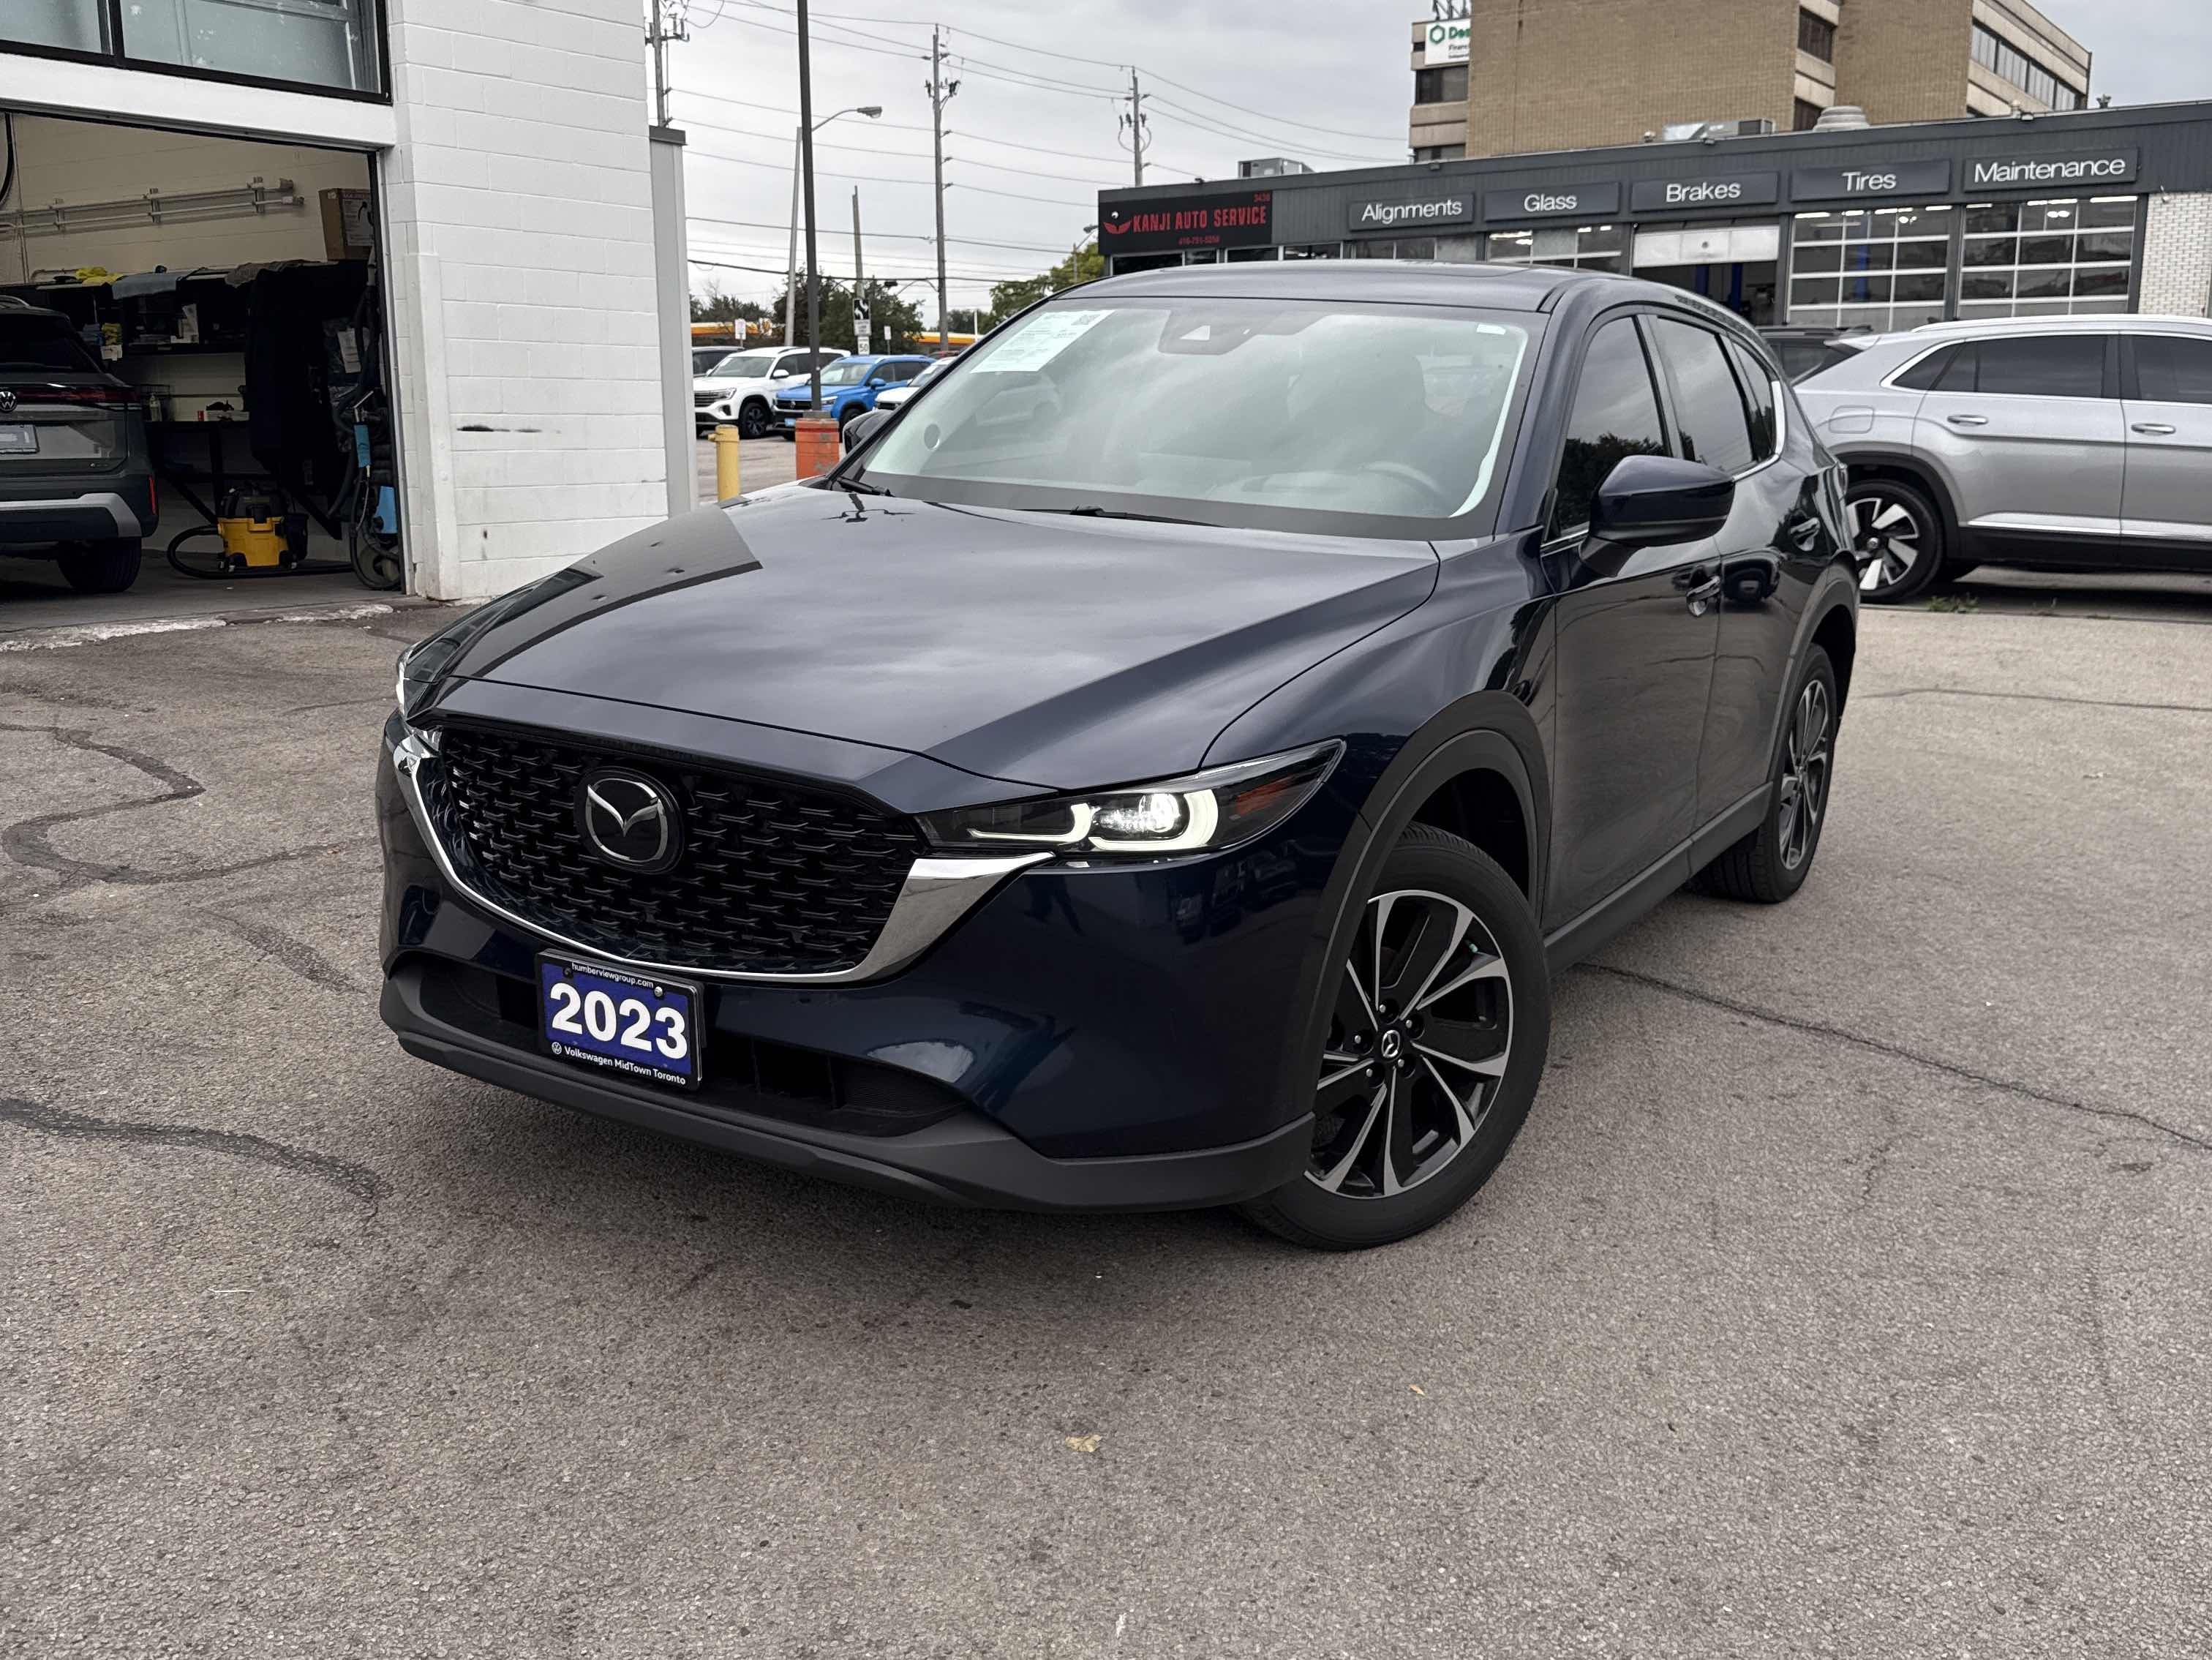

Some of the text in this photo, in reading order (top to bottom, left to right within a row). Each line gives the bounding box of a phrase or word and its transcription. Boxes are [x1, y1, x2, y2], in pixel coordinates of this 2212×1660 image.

[1842, 171, 1896, 192] Tires
[1974, 157, 2126, 183] Maintenance
[1524, 194, 1577, 212] Glass
[1665, 181, 1741, 203] Brakes
[1134, 206, 1266, 233] KANJI AUTO SERVICE
[1361, 199, 1462, 224] Alignments
[571, 962, 654, 988] humberviewgroup.com
[550, 983, 688, 1059] 2023
[564, 1045, 613, 1066] Volkswagen
[614, 1059, 652, 1076] MidTown
[652, 1068, 686, 1085] Toronto
